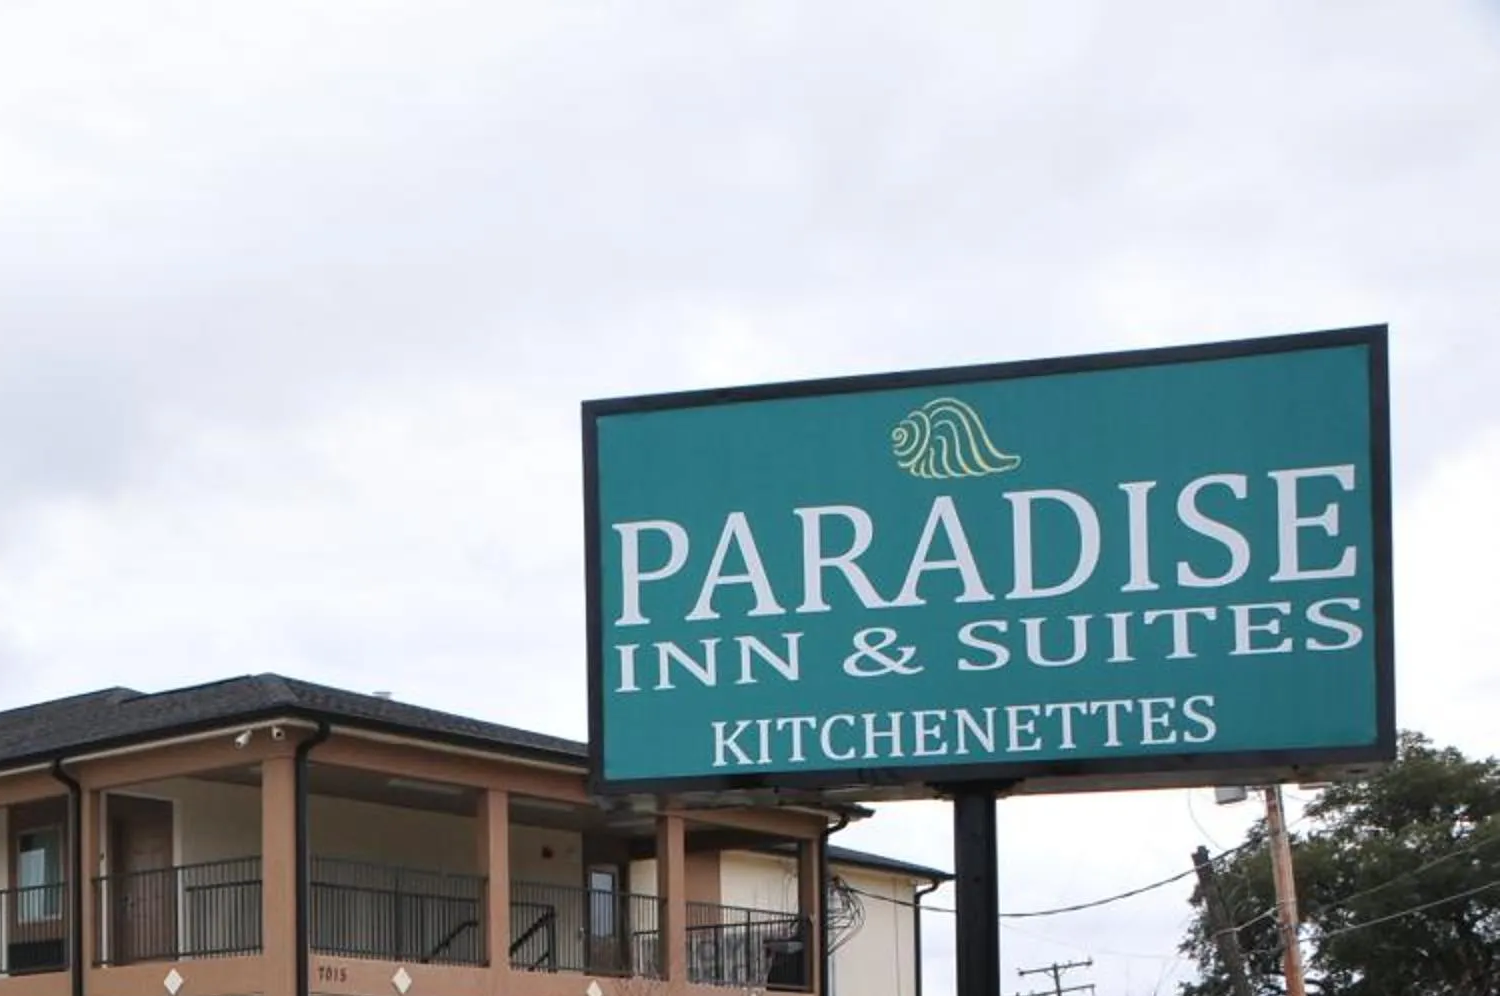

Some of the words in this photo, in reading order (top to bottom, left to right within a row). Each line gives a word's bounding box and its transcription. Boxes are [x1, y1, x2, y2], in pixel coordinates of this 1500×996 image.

[612, 463, 1357, 626] PARADISE
[615, 632, 803, 693] INN
[842, 627, 924, 678] &
[957, 598, 1363, 671] SUITES
[711, 695, 1217, 767] KITCHENETTES
